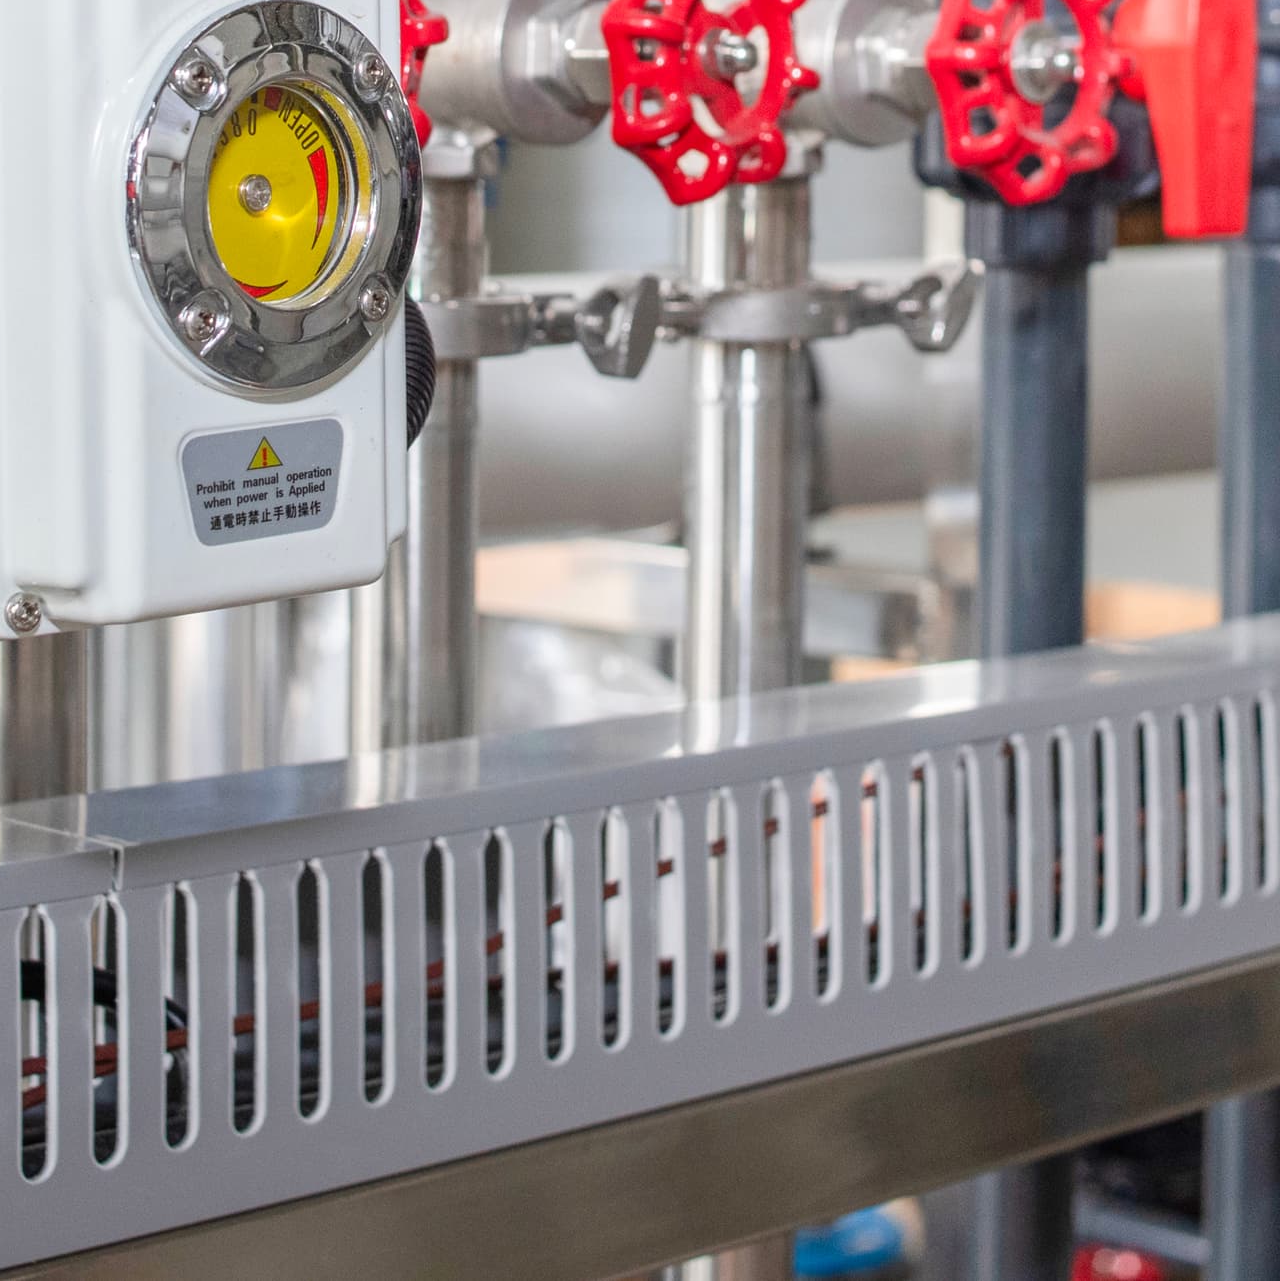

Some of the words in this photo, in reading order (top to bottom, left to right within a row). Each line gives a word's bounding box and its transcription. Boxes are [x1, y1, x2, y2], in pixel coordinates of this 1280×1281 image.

[278, 94, 320, 150] OPEN
[196, 479, 235, 495] Prohibit
[243, 473, 279, 488] manual
[286, 466, 332, 483] operation
[203, 496, 232, 509] when
[236, 491, 268, 506] power
[275, 487, 284, 499] is
[288, 481, 326, 498] Applied
[210, 501, 321, 530] 通電時禁止手動操作
